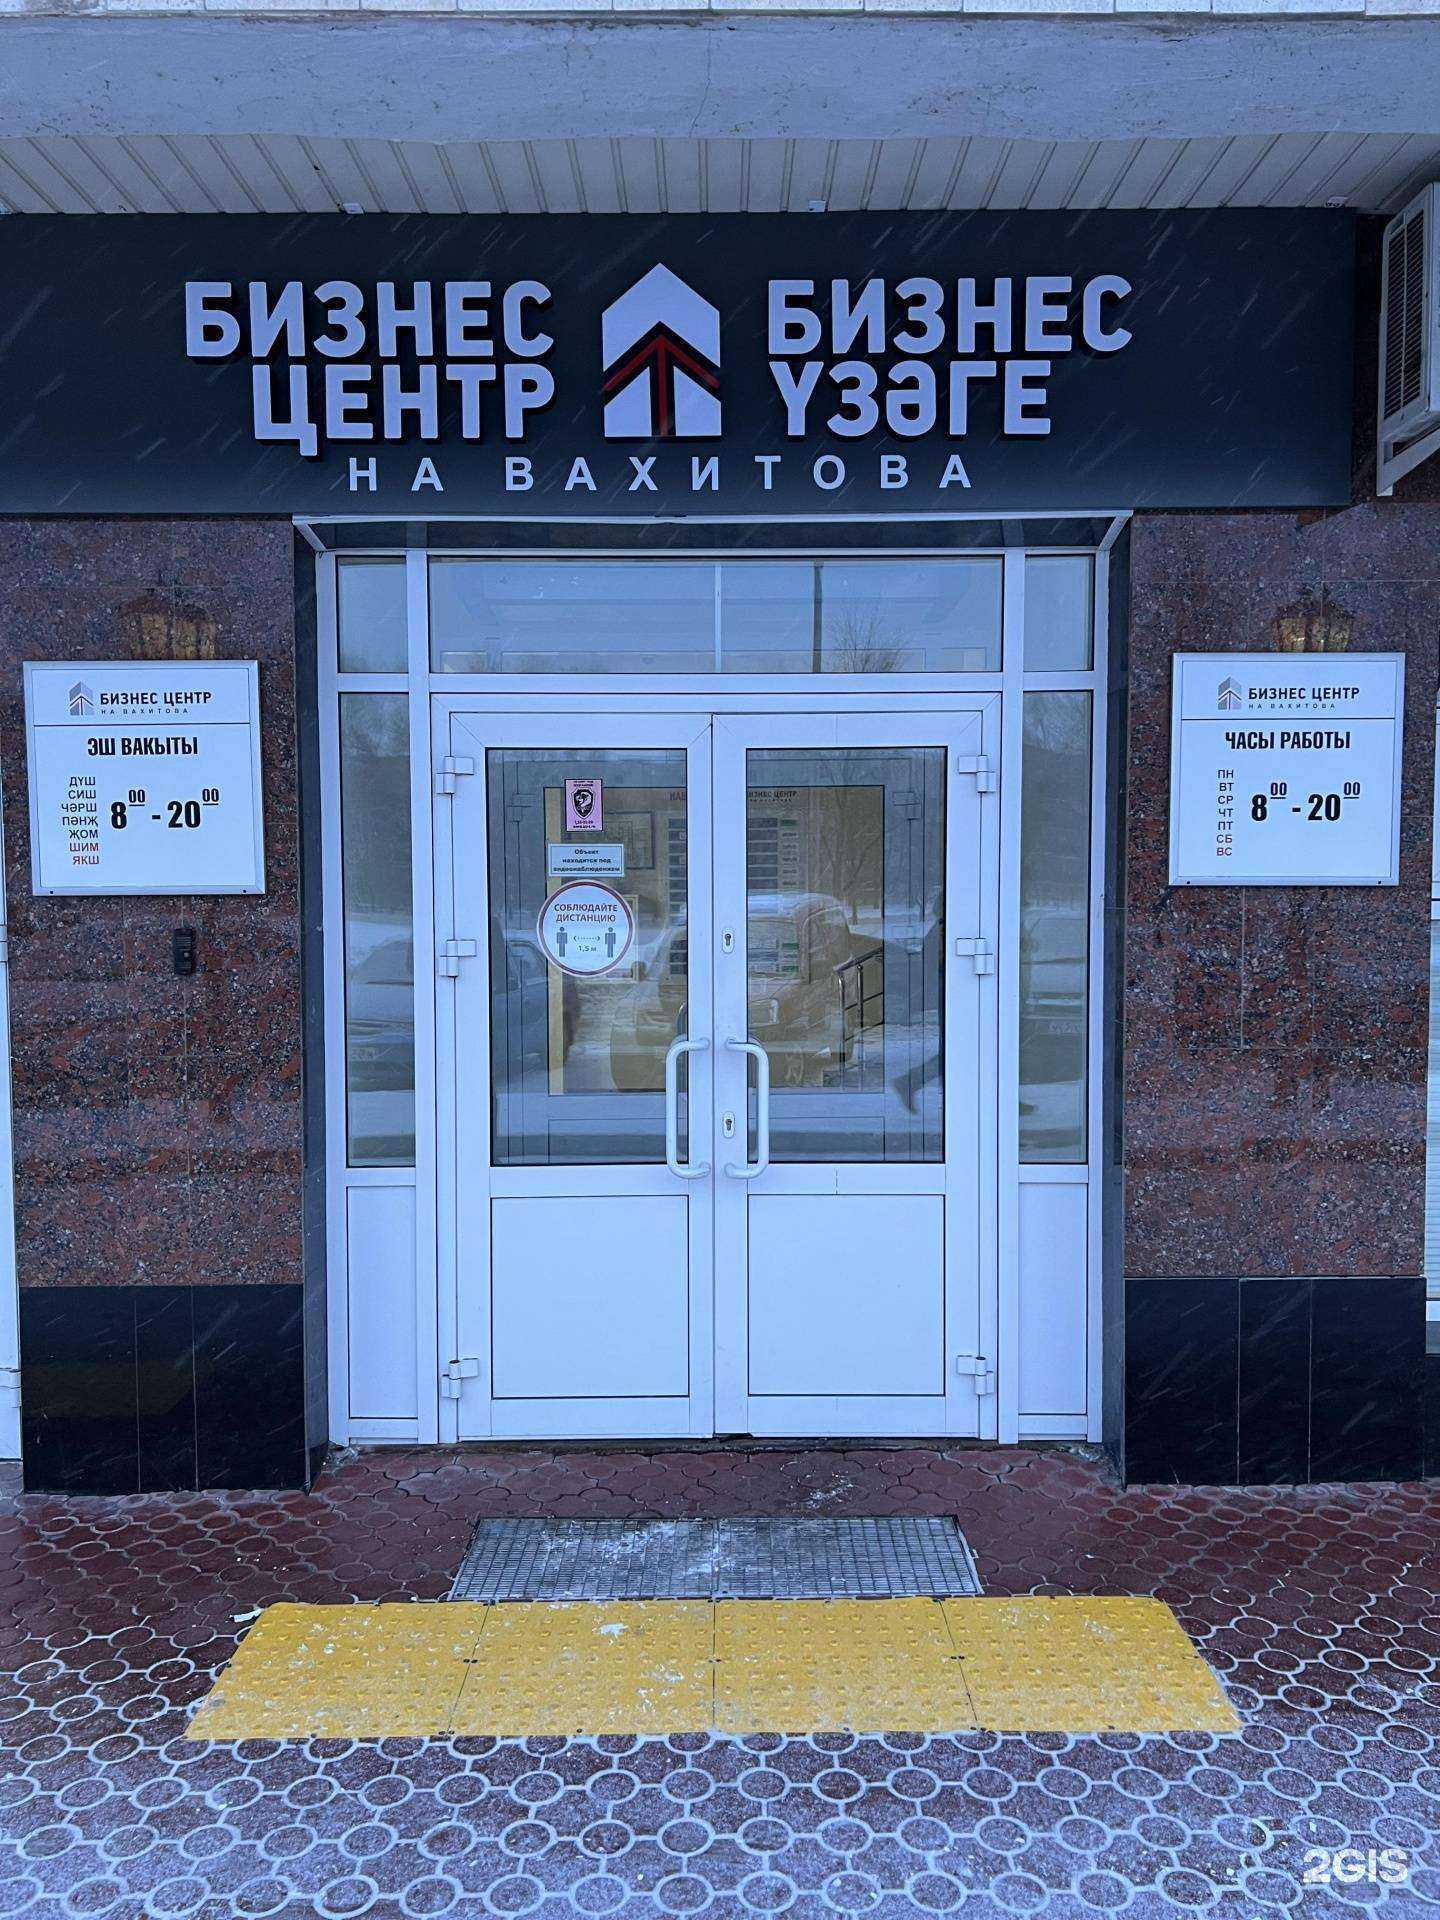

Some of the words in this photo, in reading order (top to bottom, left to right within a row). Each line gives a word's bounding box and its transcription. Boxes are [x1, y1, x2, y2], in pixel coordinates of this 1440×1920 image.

[185, 280, 554, 357] БИЗНЕС
[768, 275, 1133, 354] БИЗНЕС
[252, 363, 555, 456] ЦЕНТР
[349, 456, 444, 492] НА
[504, 454, 972, 492] ВАХИТОВА
[100, 692, 158, 705] БИЗНЕС
[163, 691, 212, 706] ЦЕНТР
[1248, 687, 1306, 700] БИЗНЕС
[1312, 687, 1360, 701] ЦЕНТР
[1225, 731, 1275, 750] ЧАСЫ
[1280, 731, 1350, 749] РАБОТЫ
[87, 737, 116, 757] ЭШ
[121, 736, 198, 756] ВАКЫТЫ
[1217, 769, 1234, 779] ПН
[1219, 782, 1234, 792] ВТ
[68, 790, 97, 799] СИШ
[1217, 795, 1234, 805] СР
[1218, 808, 1234, 817] ЧТ
[1217, 821, 1234, 830] ПТ
[1216, 834, 1233, 843] СБ
[69, 842, 99, 852] ШИМ
[1216, 847, 1233, 856] ВС
[72, 856, 100, 865] ЯКШ
[554, 903, 618, 912] СОБЛЮДАЙТЕ
[555, 913, 617, 924] ДИСТАНЦИЮ
